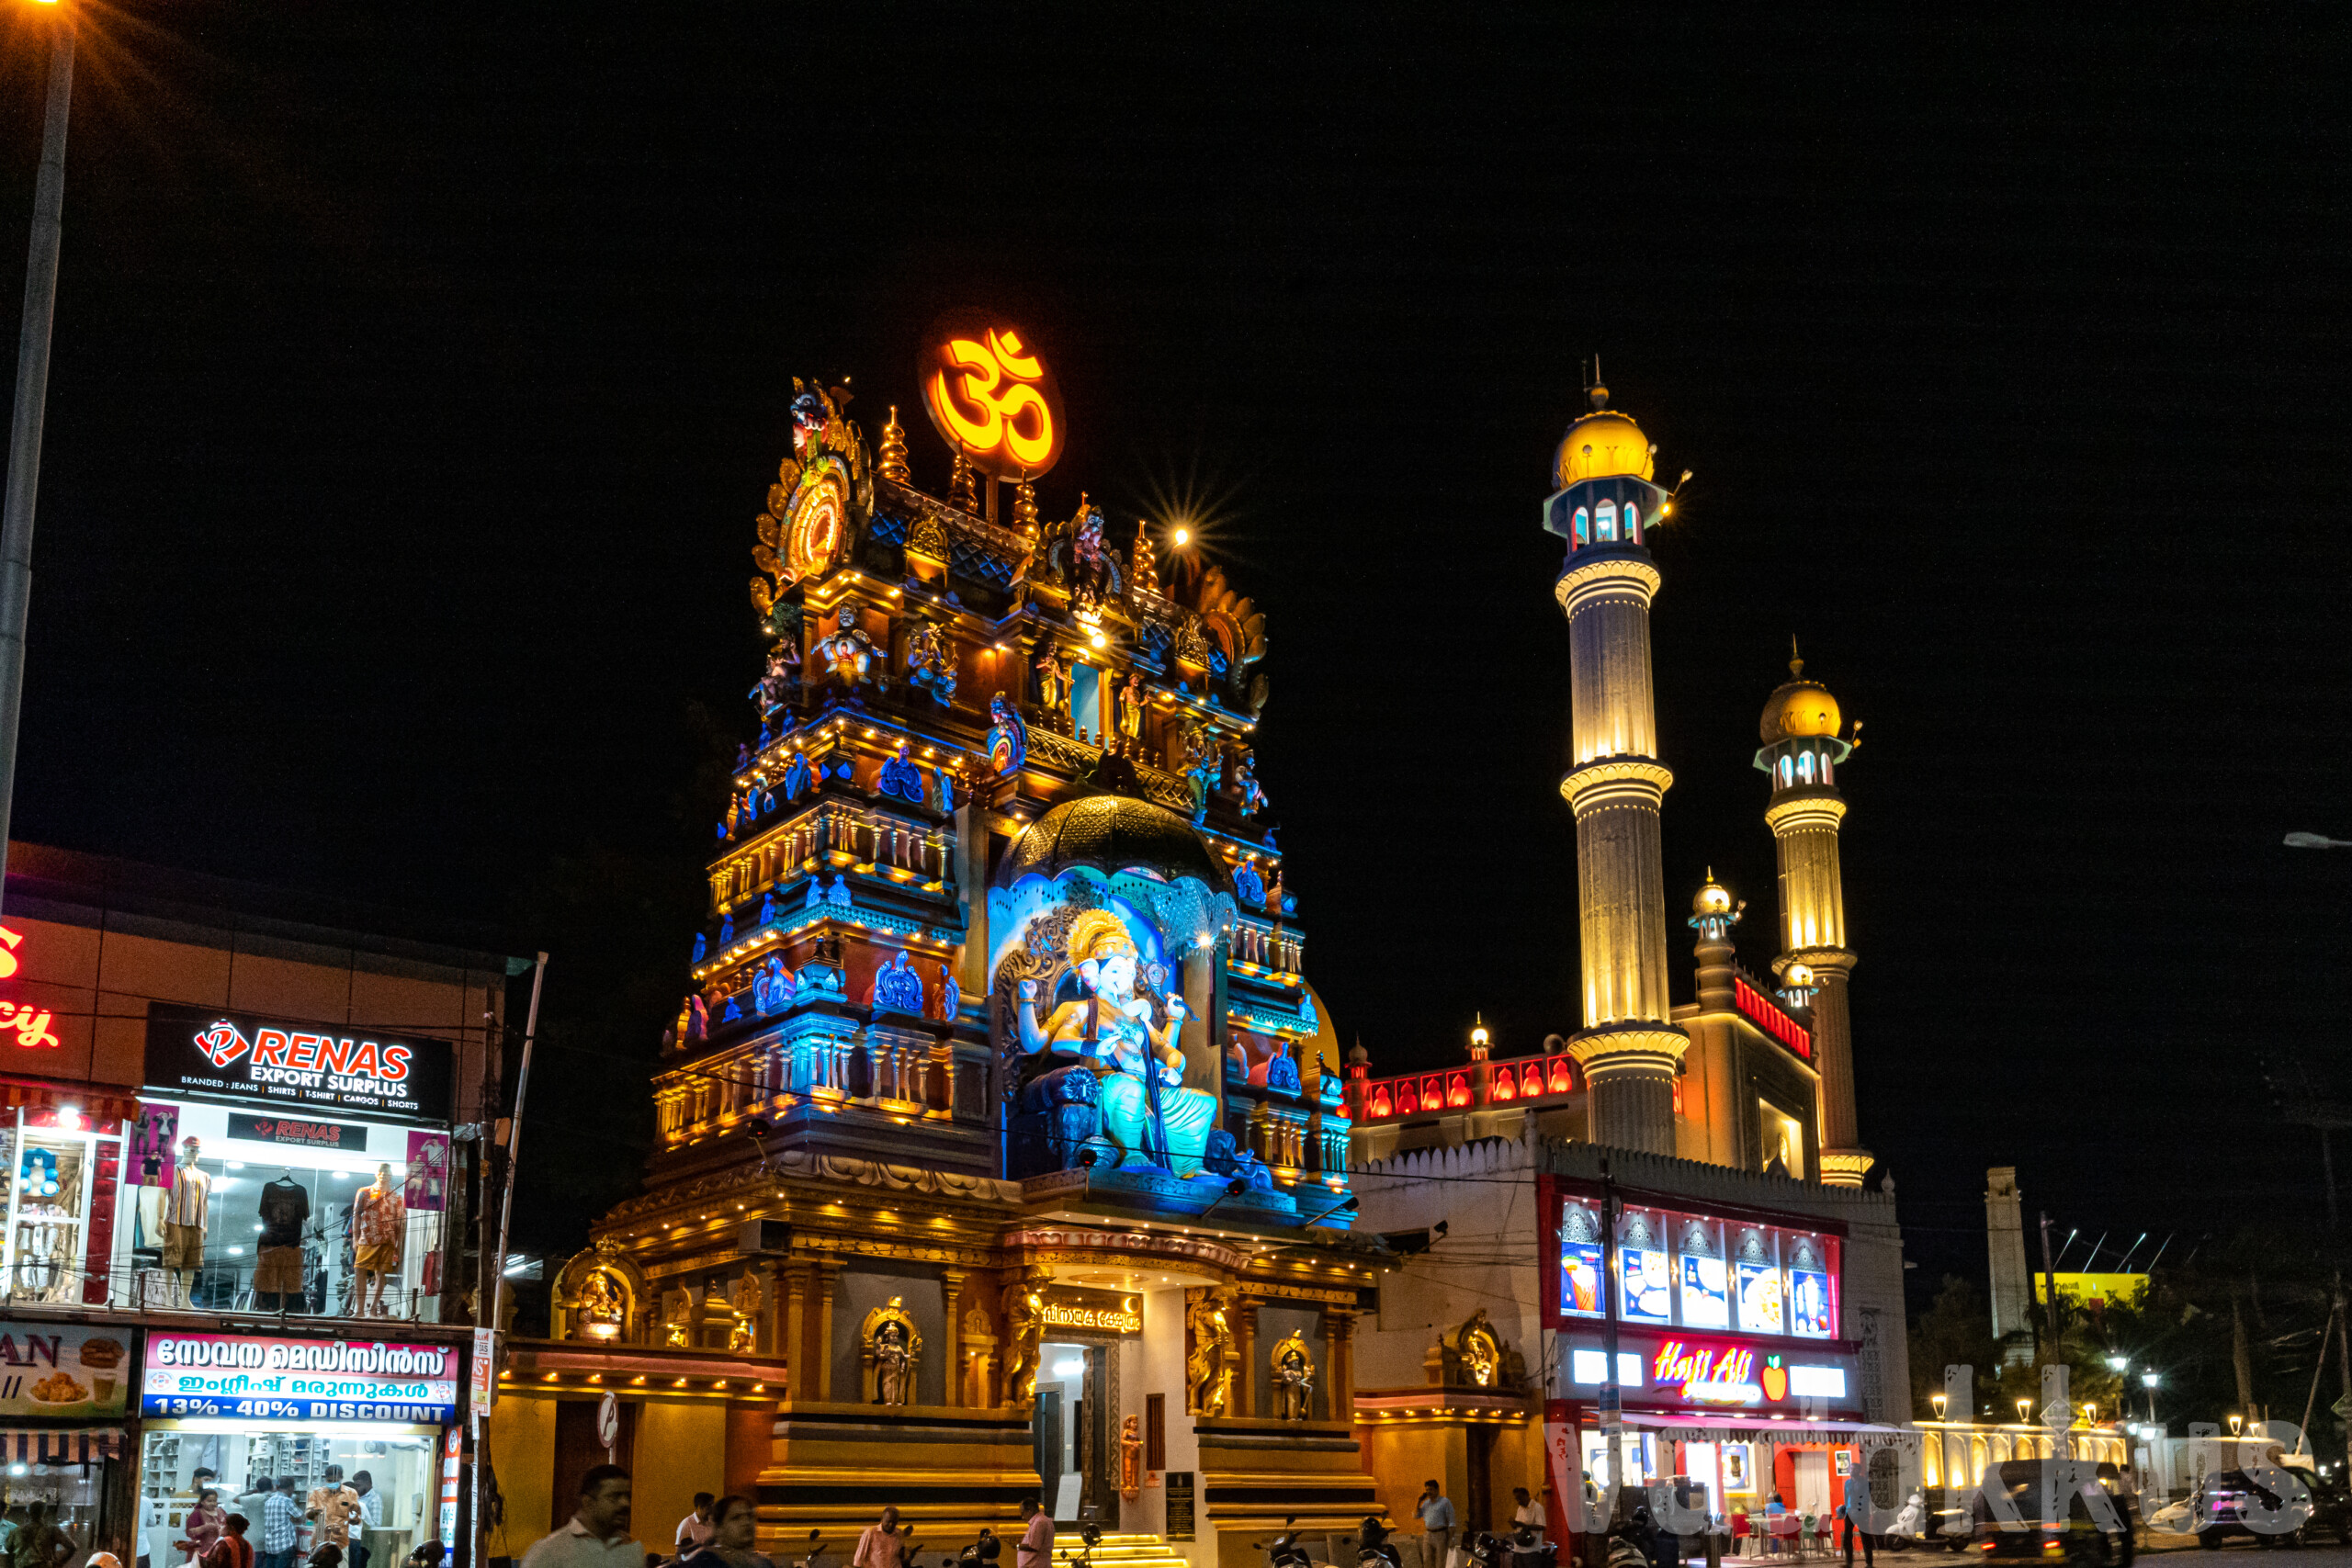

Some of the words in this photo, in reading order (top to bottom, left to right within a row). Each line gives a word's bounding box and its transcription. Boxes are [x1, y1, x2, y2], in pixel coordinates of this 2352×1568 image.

[249, 1028, 413, 1081] RENAS
[181, 1076, 224, 1088] BRANDED
[231, 1081, 258, 1092] JEANS
[267, 1086, 296, 1096] SHIRTS
[305, 1089, 335, 1100] T-SHIRT
[343, 1094, 379, 1106] CARGOS
[387, 1100, 419, 1111] SHORTS
[250, 1066, 323, 1089] EXPORT
[327, 1076, 408, 1098] SURPLUS
[276, 1121, 342, 1142] RENAS
[276, 1135, 306, 1145] EXPORT
[306, 1138, 339, 1148] SURPLUS
[156, 1338, 265, 1368] സേവന
[271, 1340, 449, 1376] മെഡിസിൻസ്
[1655, 1341, 1713, 1399] Haji
[1712, 1347, 1753, 1384] Ali
[178, 1374, 287, 1395] ഇംഗ്ലീഷ്
[291, 1382, 429, 1399] മരുന്നുകൾ
[310, 1403, 446, 1423] DISCOUNT
